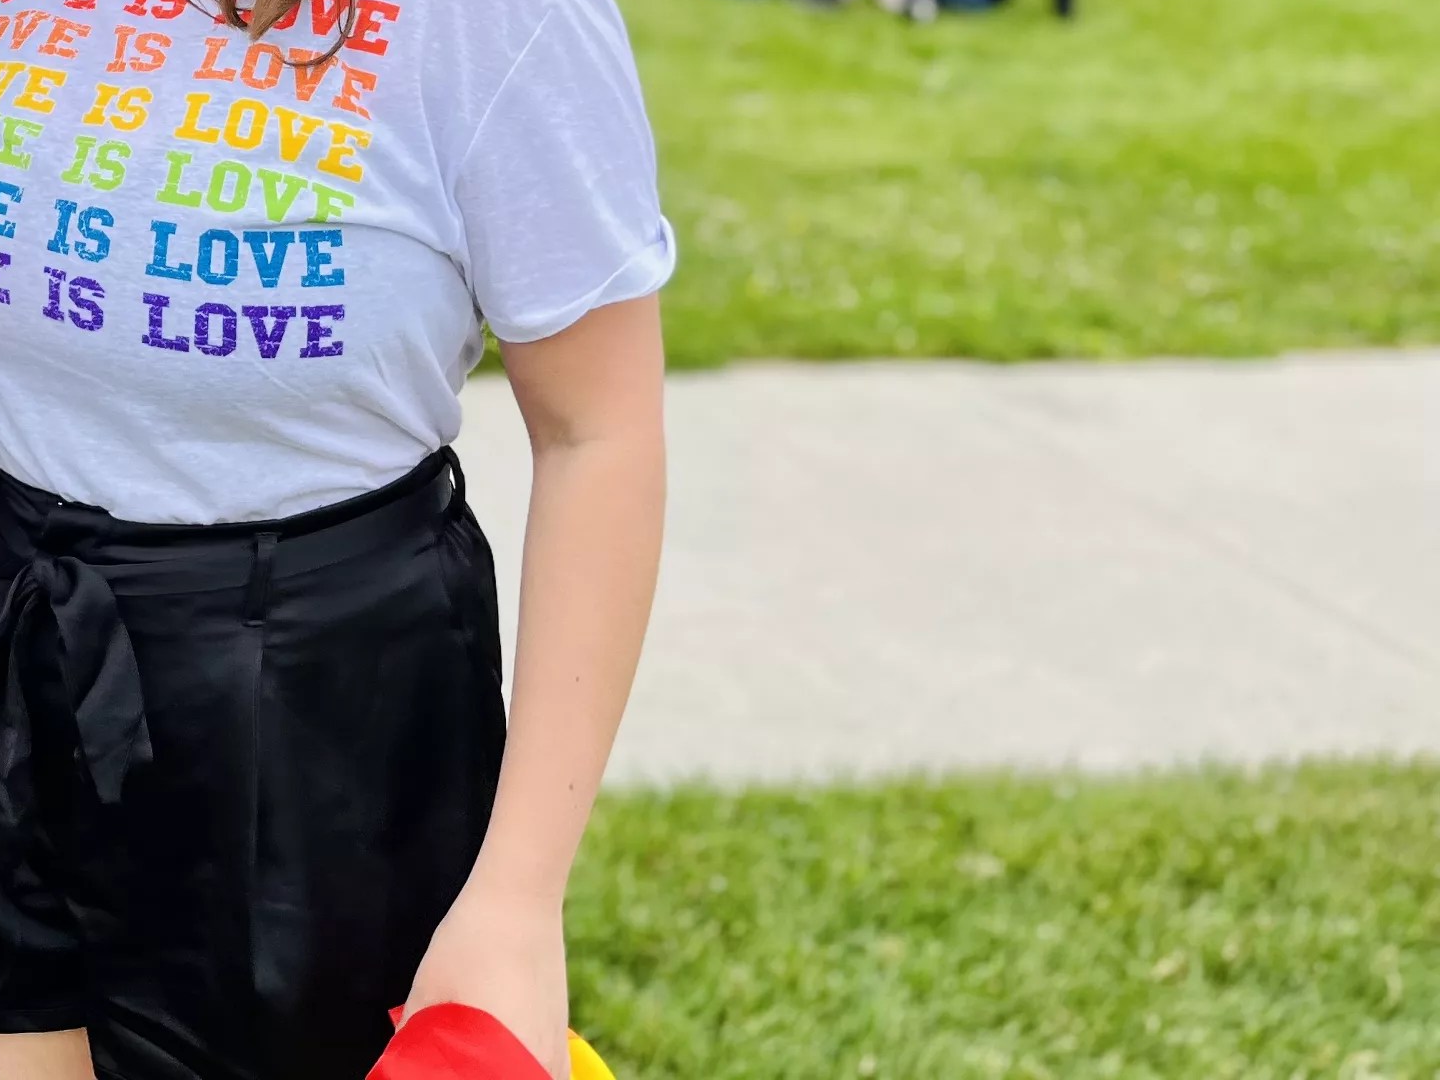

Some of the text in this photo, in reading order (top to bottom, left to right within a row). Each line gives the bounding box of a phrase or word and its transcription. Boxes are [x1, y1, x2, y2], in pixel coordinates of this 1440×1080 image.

[105, 23, 172, 74] IS
[192, 36, 378, 121] LOVE
[60, 135, 132, 192] IS
[155, 150, 356, 224] LOVE
[81, 82, 154, 131] IS
[174, 91, 374, 183] LOVE
[46, 198, 116, 263] IS
[144, 220, 346, 288] LOVE
[42, 265, 106, 333] IS
[141, 291, 345, 359] LOVE
